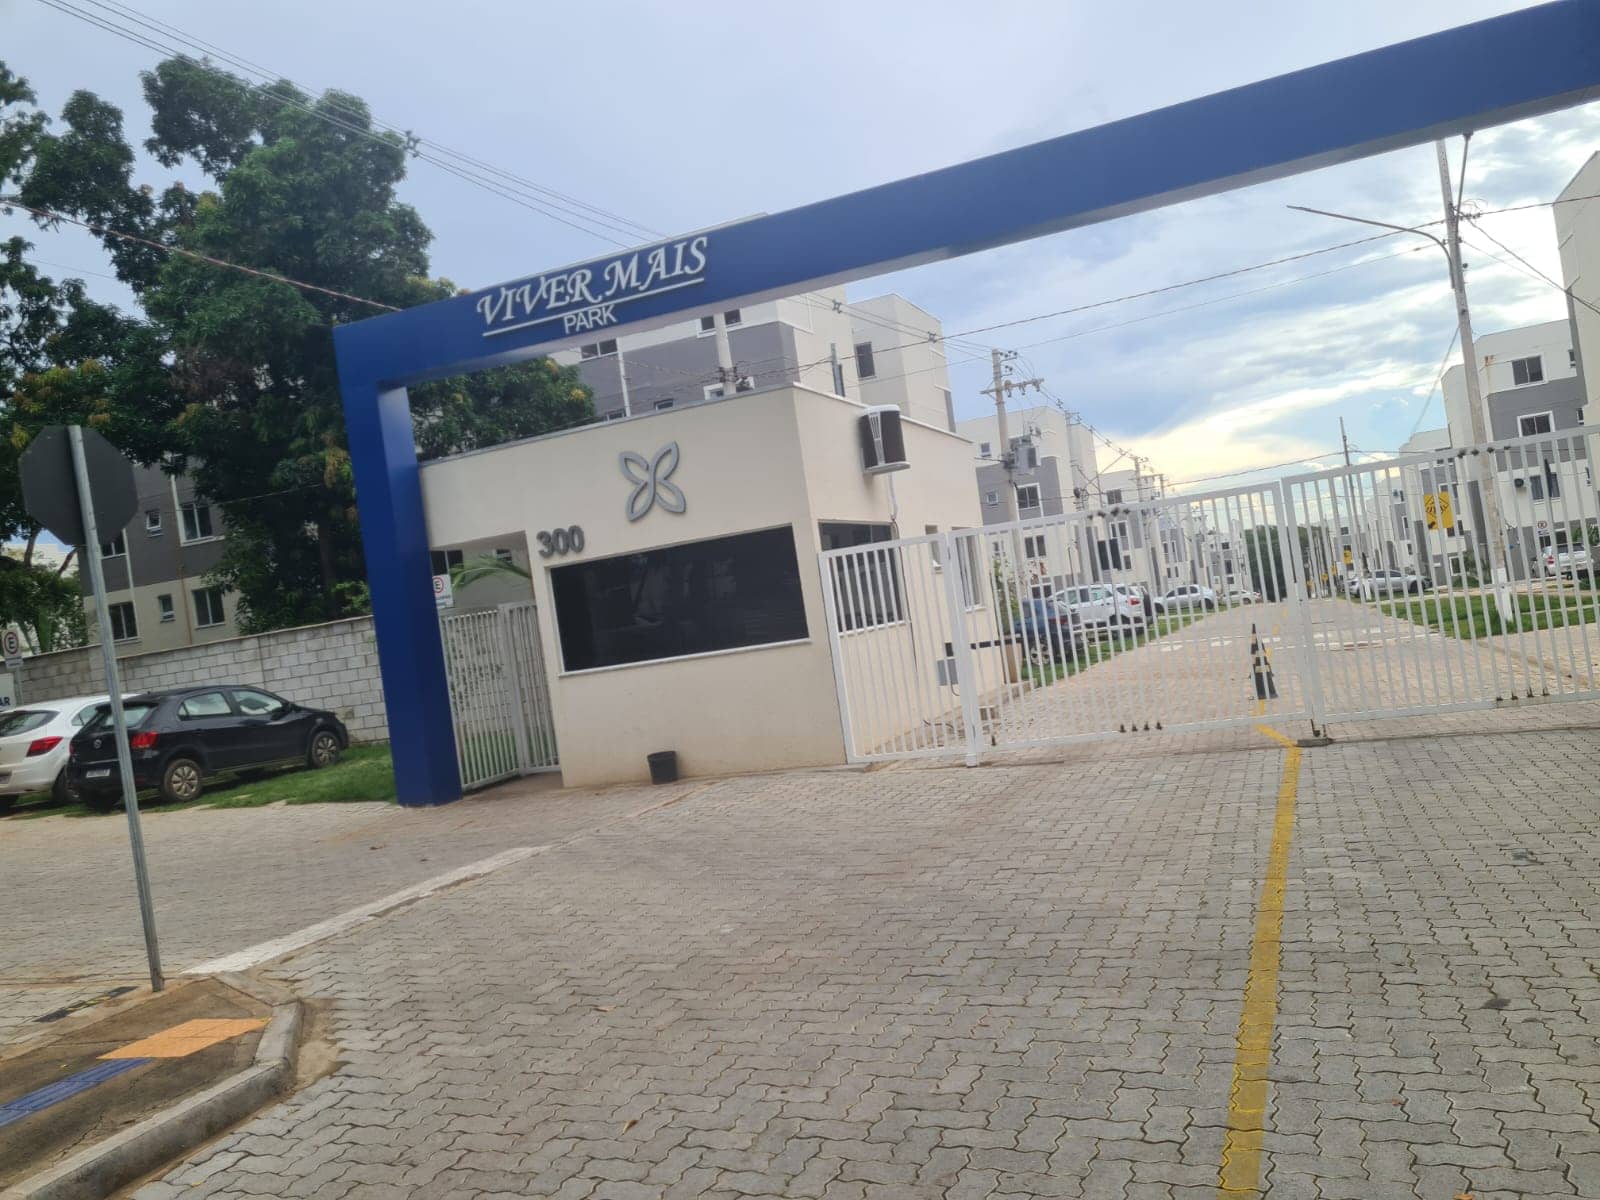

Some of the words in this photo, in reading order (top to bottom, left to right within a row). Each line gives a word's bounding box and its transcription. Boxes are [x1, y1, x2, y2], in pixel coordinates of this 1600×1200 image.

[476, 268, 602, 325] VIVER
[604, 236, 708, 297] MAIS
[563, 305, 619, 334] PARK
[536, 525, 585, 558] 300
